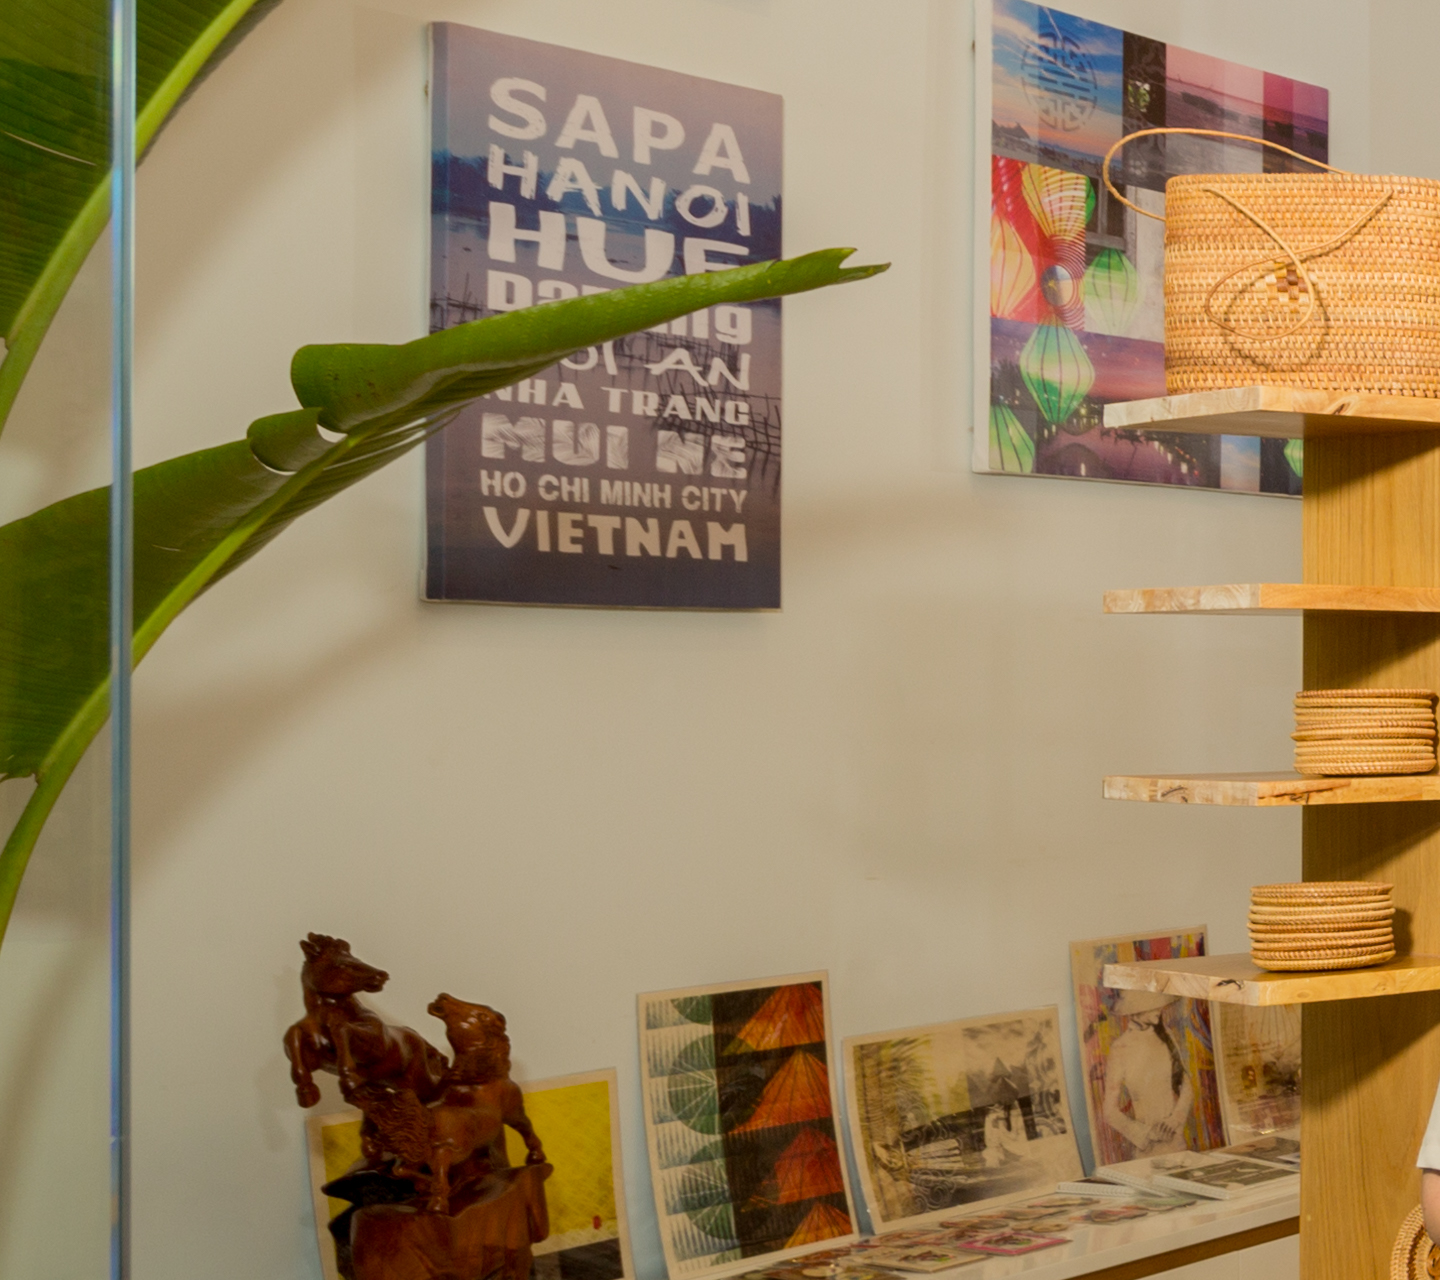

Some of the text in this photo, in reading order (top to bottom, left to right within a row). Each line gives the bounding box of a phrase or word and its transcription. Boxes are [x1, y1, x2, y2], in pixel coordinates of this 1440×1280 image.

[488, 76, 751, 184] SAPA
[487, 143, 751, 237] HANOI
[644, 347, 751, 391] AN
[600, 386, 751, 426] TRANG
[481, 412, 748, 480] MUI NE
[480, 469, 749, 514] HO CHI MINH CITY
[483, 506, 748, 562] VIETNAM
